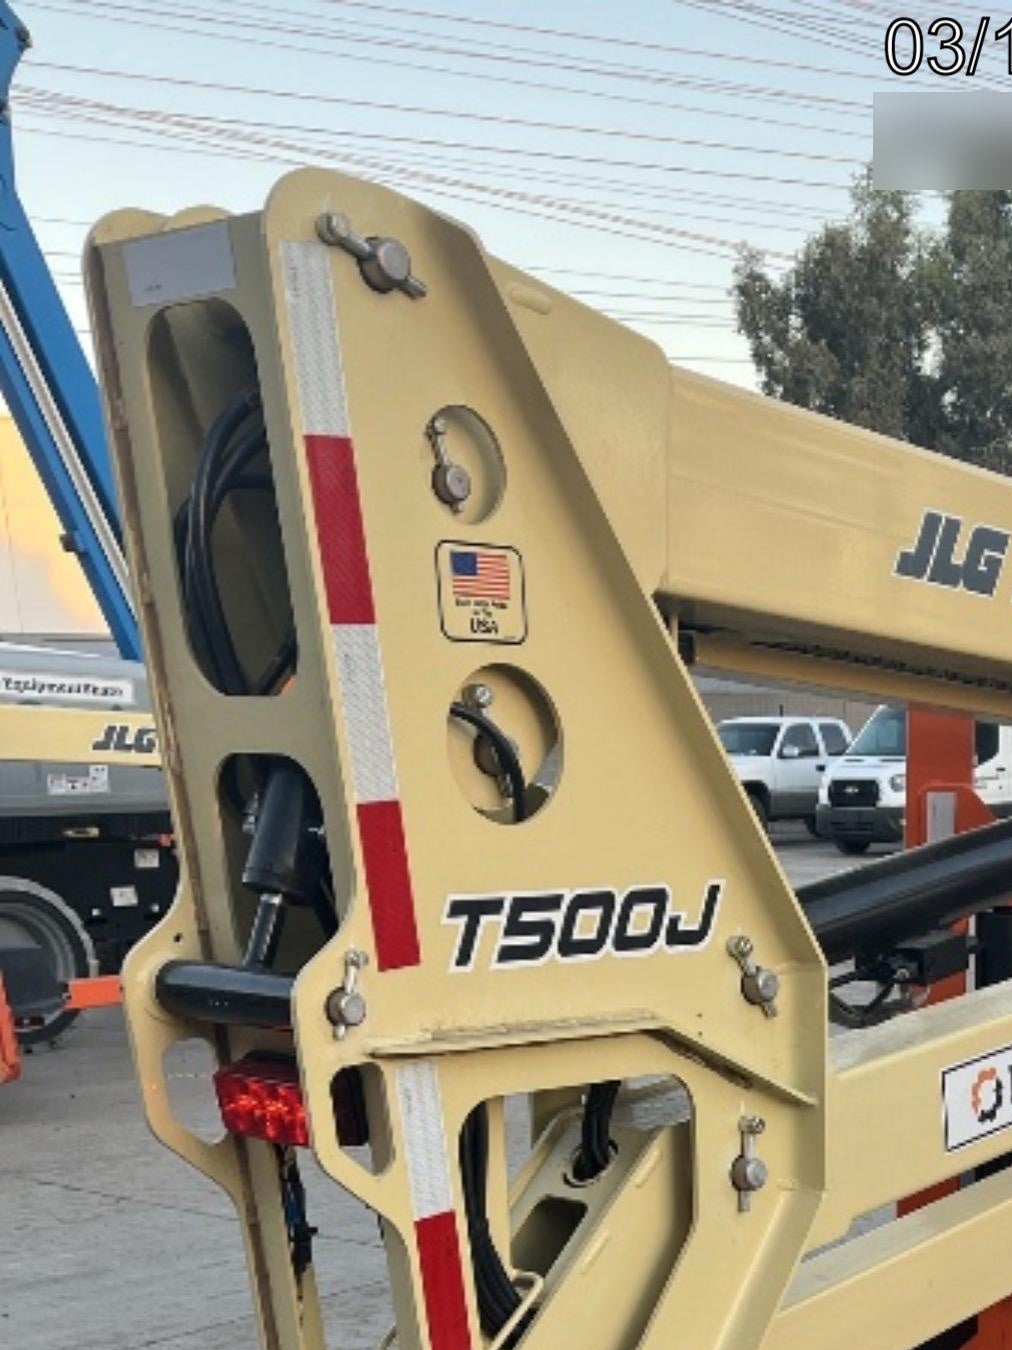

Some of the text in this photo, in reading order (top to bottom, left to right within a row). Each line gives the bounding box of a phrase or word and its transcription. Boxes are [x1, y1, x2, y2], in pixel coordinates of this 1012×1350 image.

[894, 510, 1012, 597] JLG
[92, 725, 157, 753] JLG
[445, 883, 721, 968] T500J
